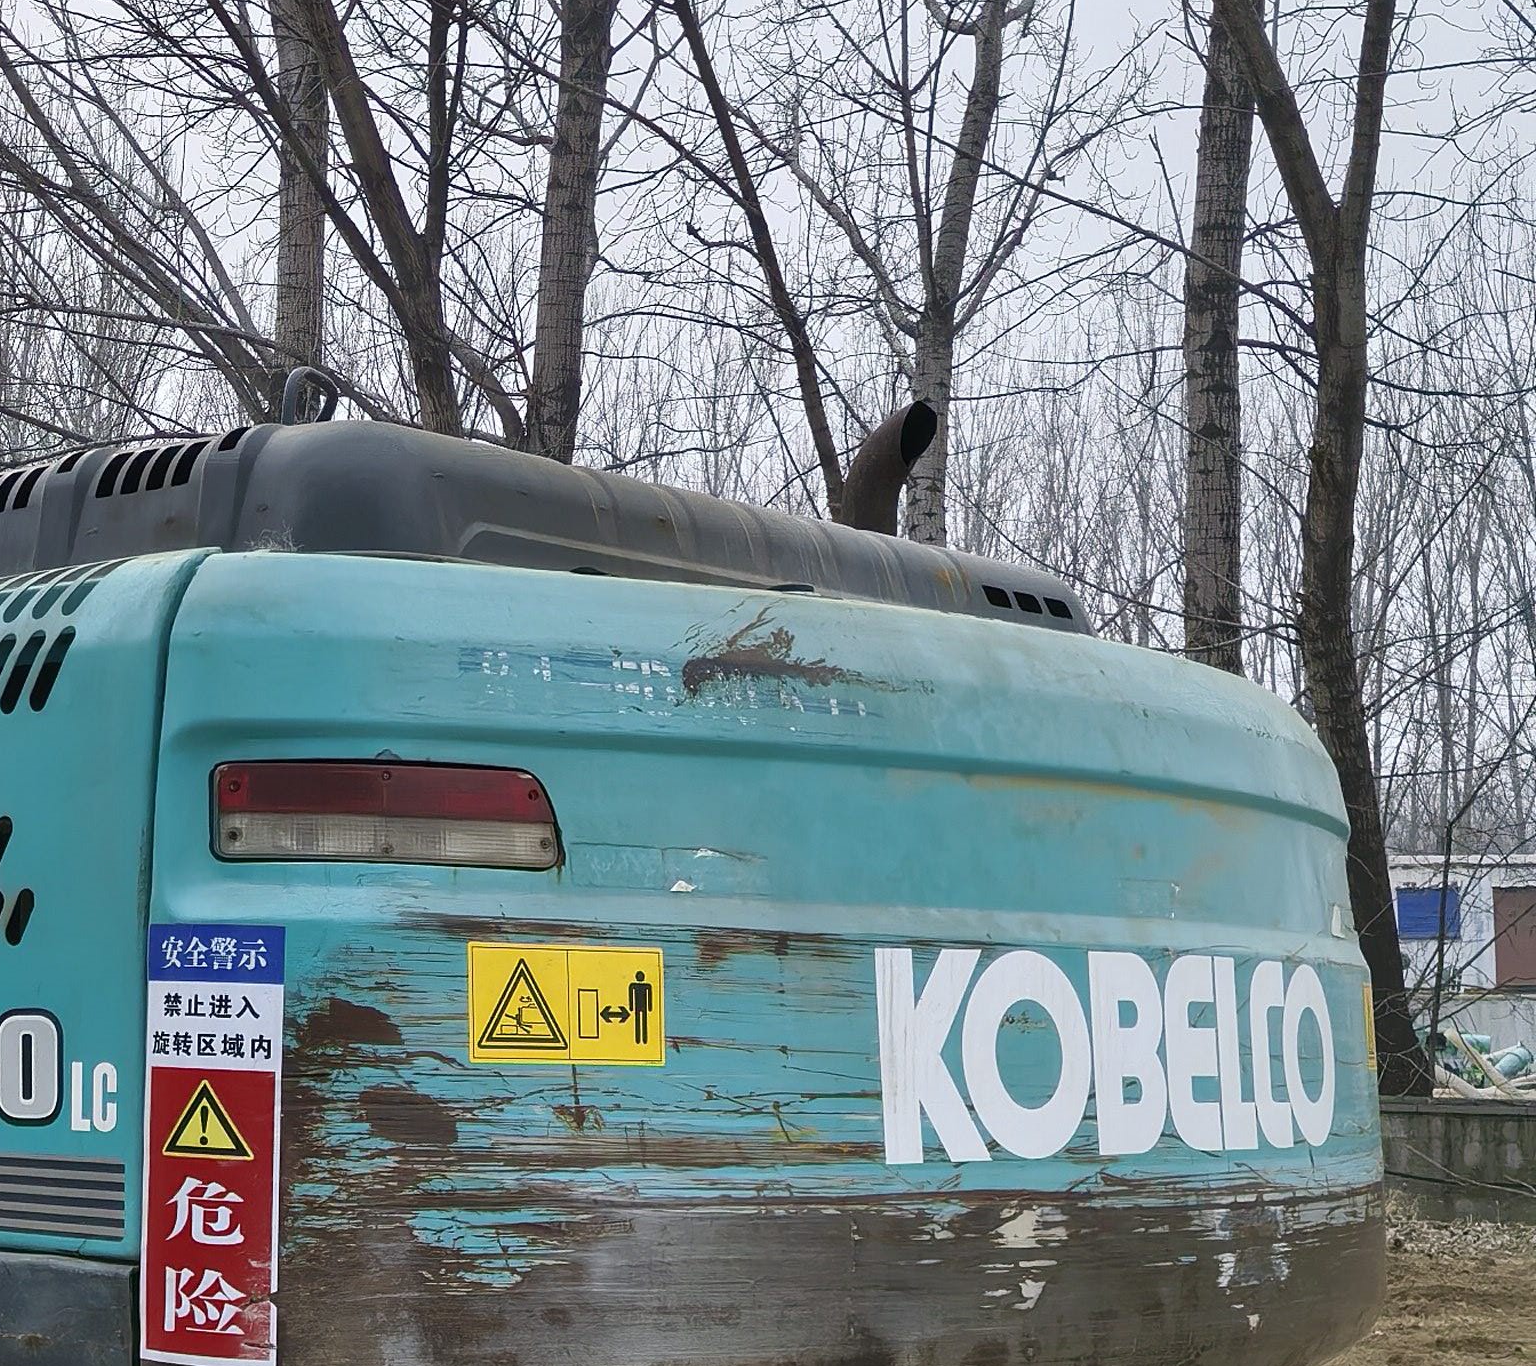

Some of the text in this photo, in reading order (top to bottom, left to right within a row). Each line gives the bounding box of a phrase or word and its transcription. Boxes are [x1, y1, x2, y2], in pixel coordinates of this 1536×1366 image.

[161, 936, 267, 970] 安全警示
[164, 993, 260, 1019] 禁止进入
[152, 1031, 272, 1060] 旋转区域内
[874, 947, 1336, 1165] KOBELCO
[71, 1061, 117, 1132] LC
[164, 1176, 247, 1335] 危险
